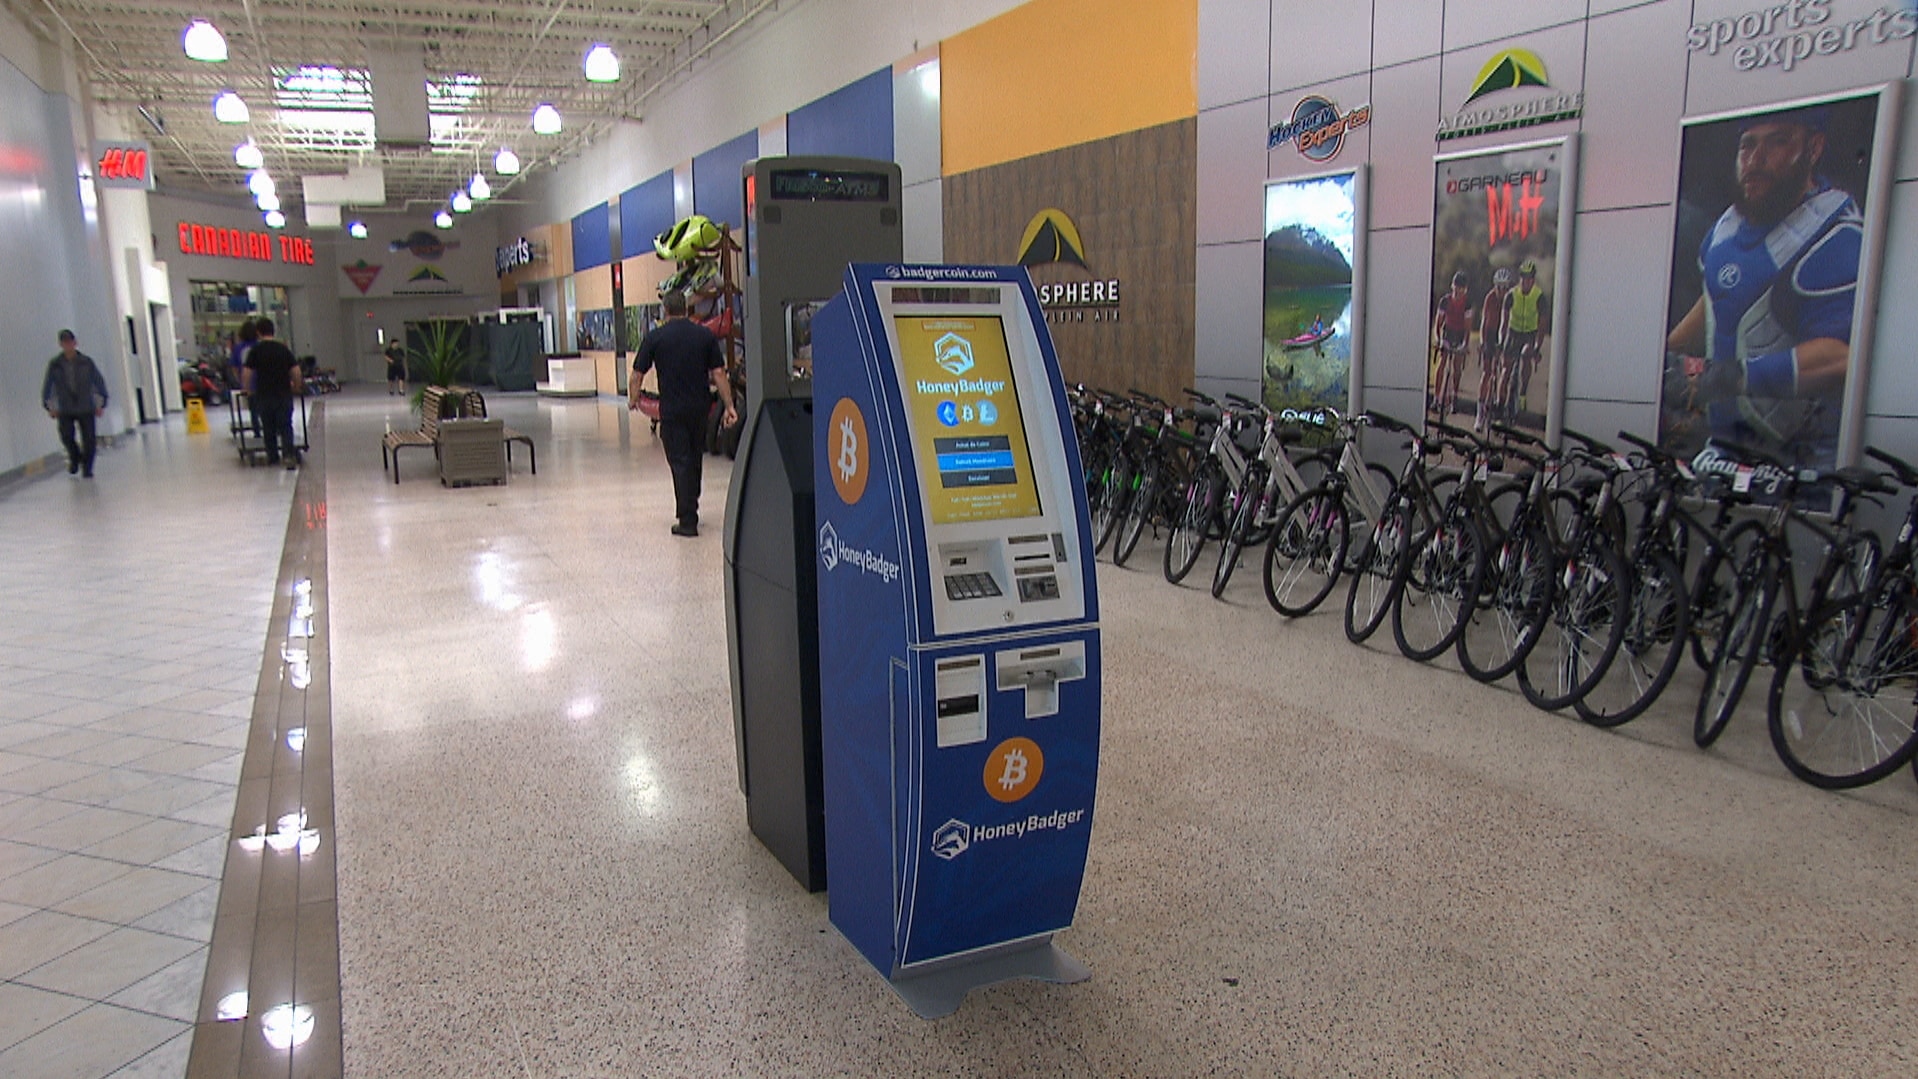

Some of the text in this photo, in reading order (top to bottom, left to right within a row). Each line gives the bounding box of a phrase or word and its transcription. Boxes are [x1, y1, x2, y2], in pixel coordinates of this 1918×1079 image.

[1686, 0, 1831, 55] sports
[1733, 8, 1917, 71] experts
[1437, 92, 1584, 129] ATMOSPHERE
[1298, 106, 1369, 152] Experts
[98, 149, 147, 180] H&M
[1458, 168, 1548, 193] GARNEAU
[178, 222, 315, 265] CANADIAN TIRE
[901, 266, 998, 280] badgercoin.com
[1035, 280, 1119, 304] SPHERE
[916, 377, 1005, 397] HoneyBadger
[838, 539, 900, 583] HoneyBadger
[973, 808, 1084, 842] HoneyBadger
